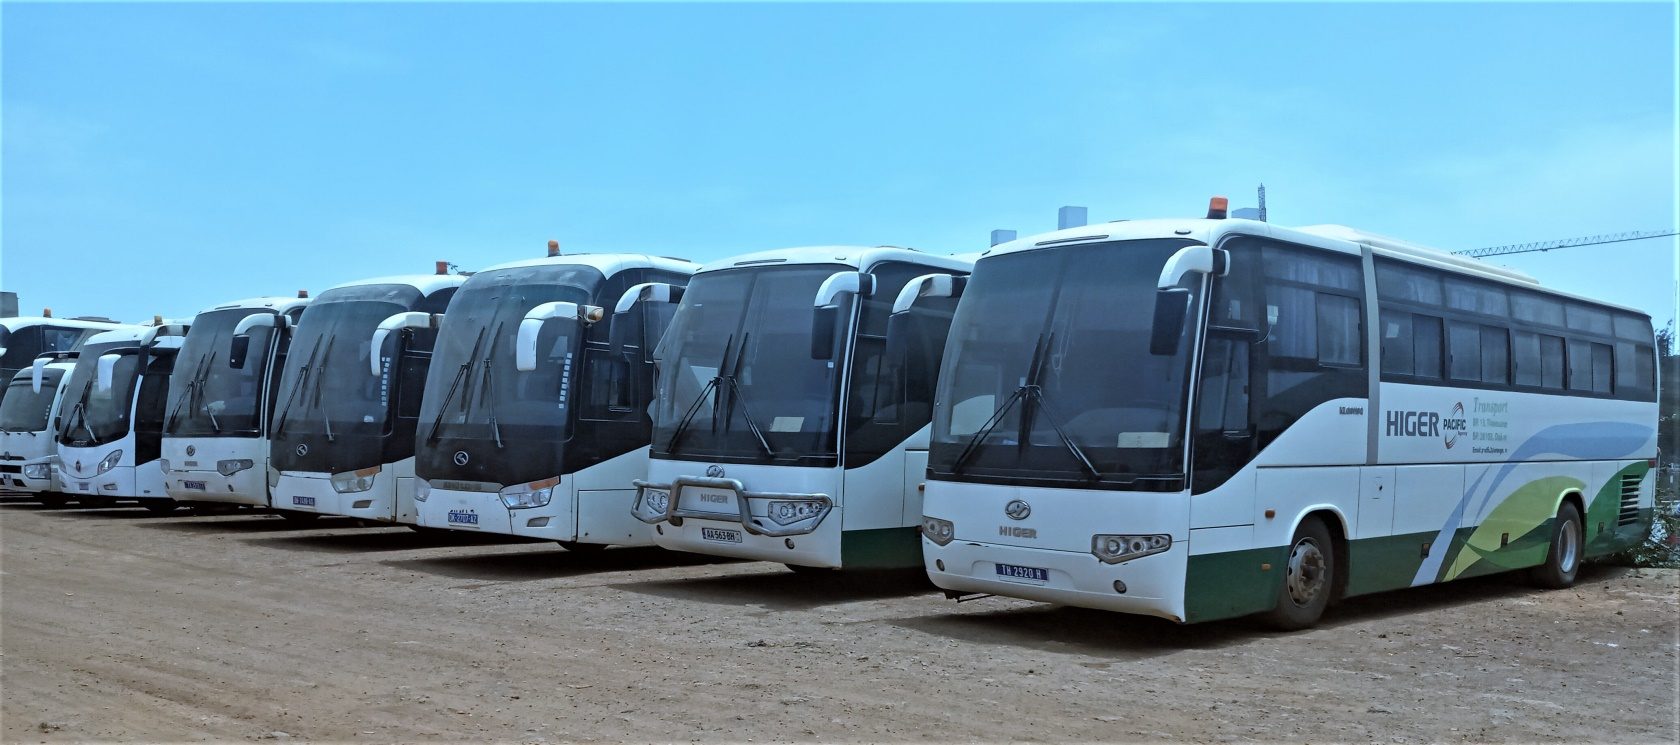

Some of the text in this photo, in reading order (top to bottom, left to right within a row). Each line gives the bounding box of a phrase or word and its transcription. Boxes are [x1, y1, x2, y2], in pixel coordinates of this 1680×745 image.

[1473, 397, 1508, 416] Transport
[1386, 411, 1440, 437] HIGER
[1443, 418, 1467, 430] PACIFIC
[700, 493, 728, 504] HIGER
[999, 526, 1037, 539] HIGER
[1002, 564, 1042, 580] TH 2920 H
